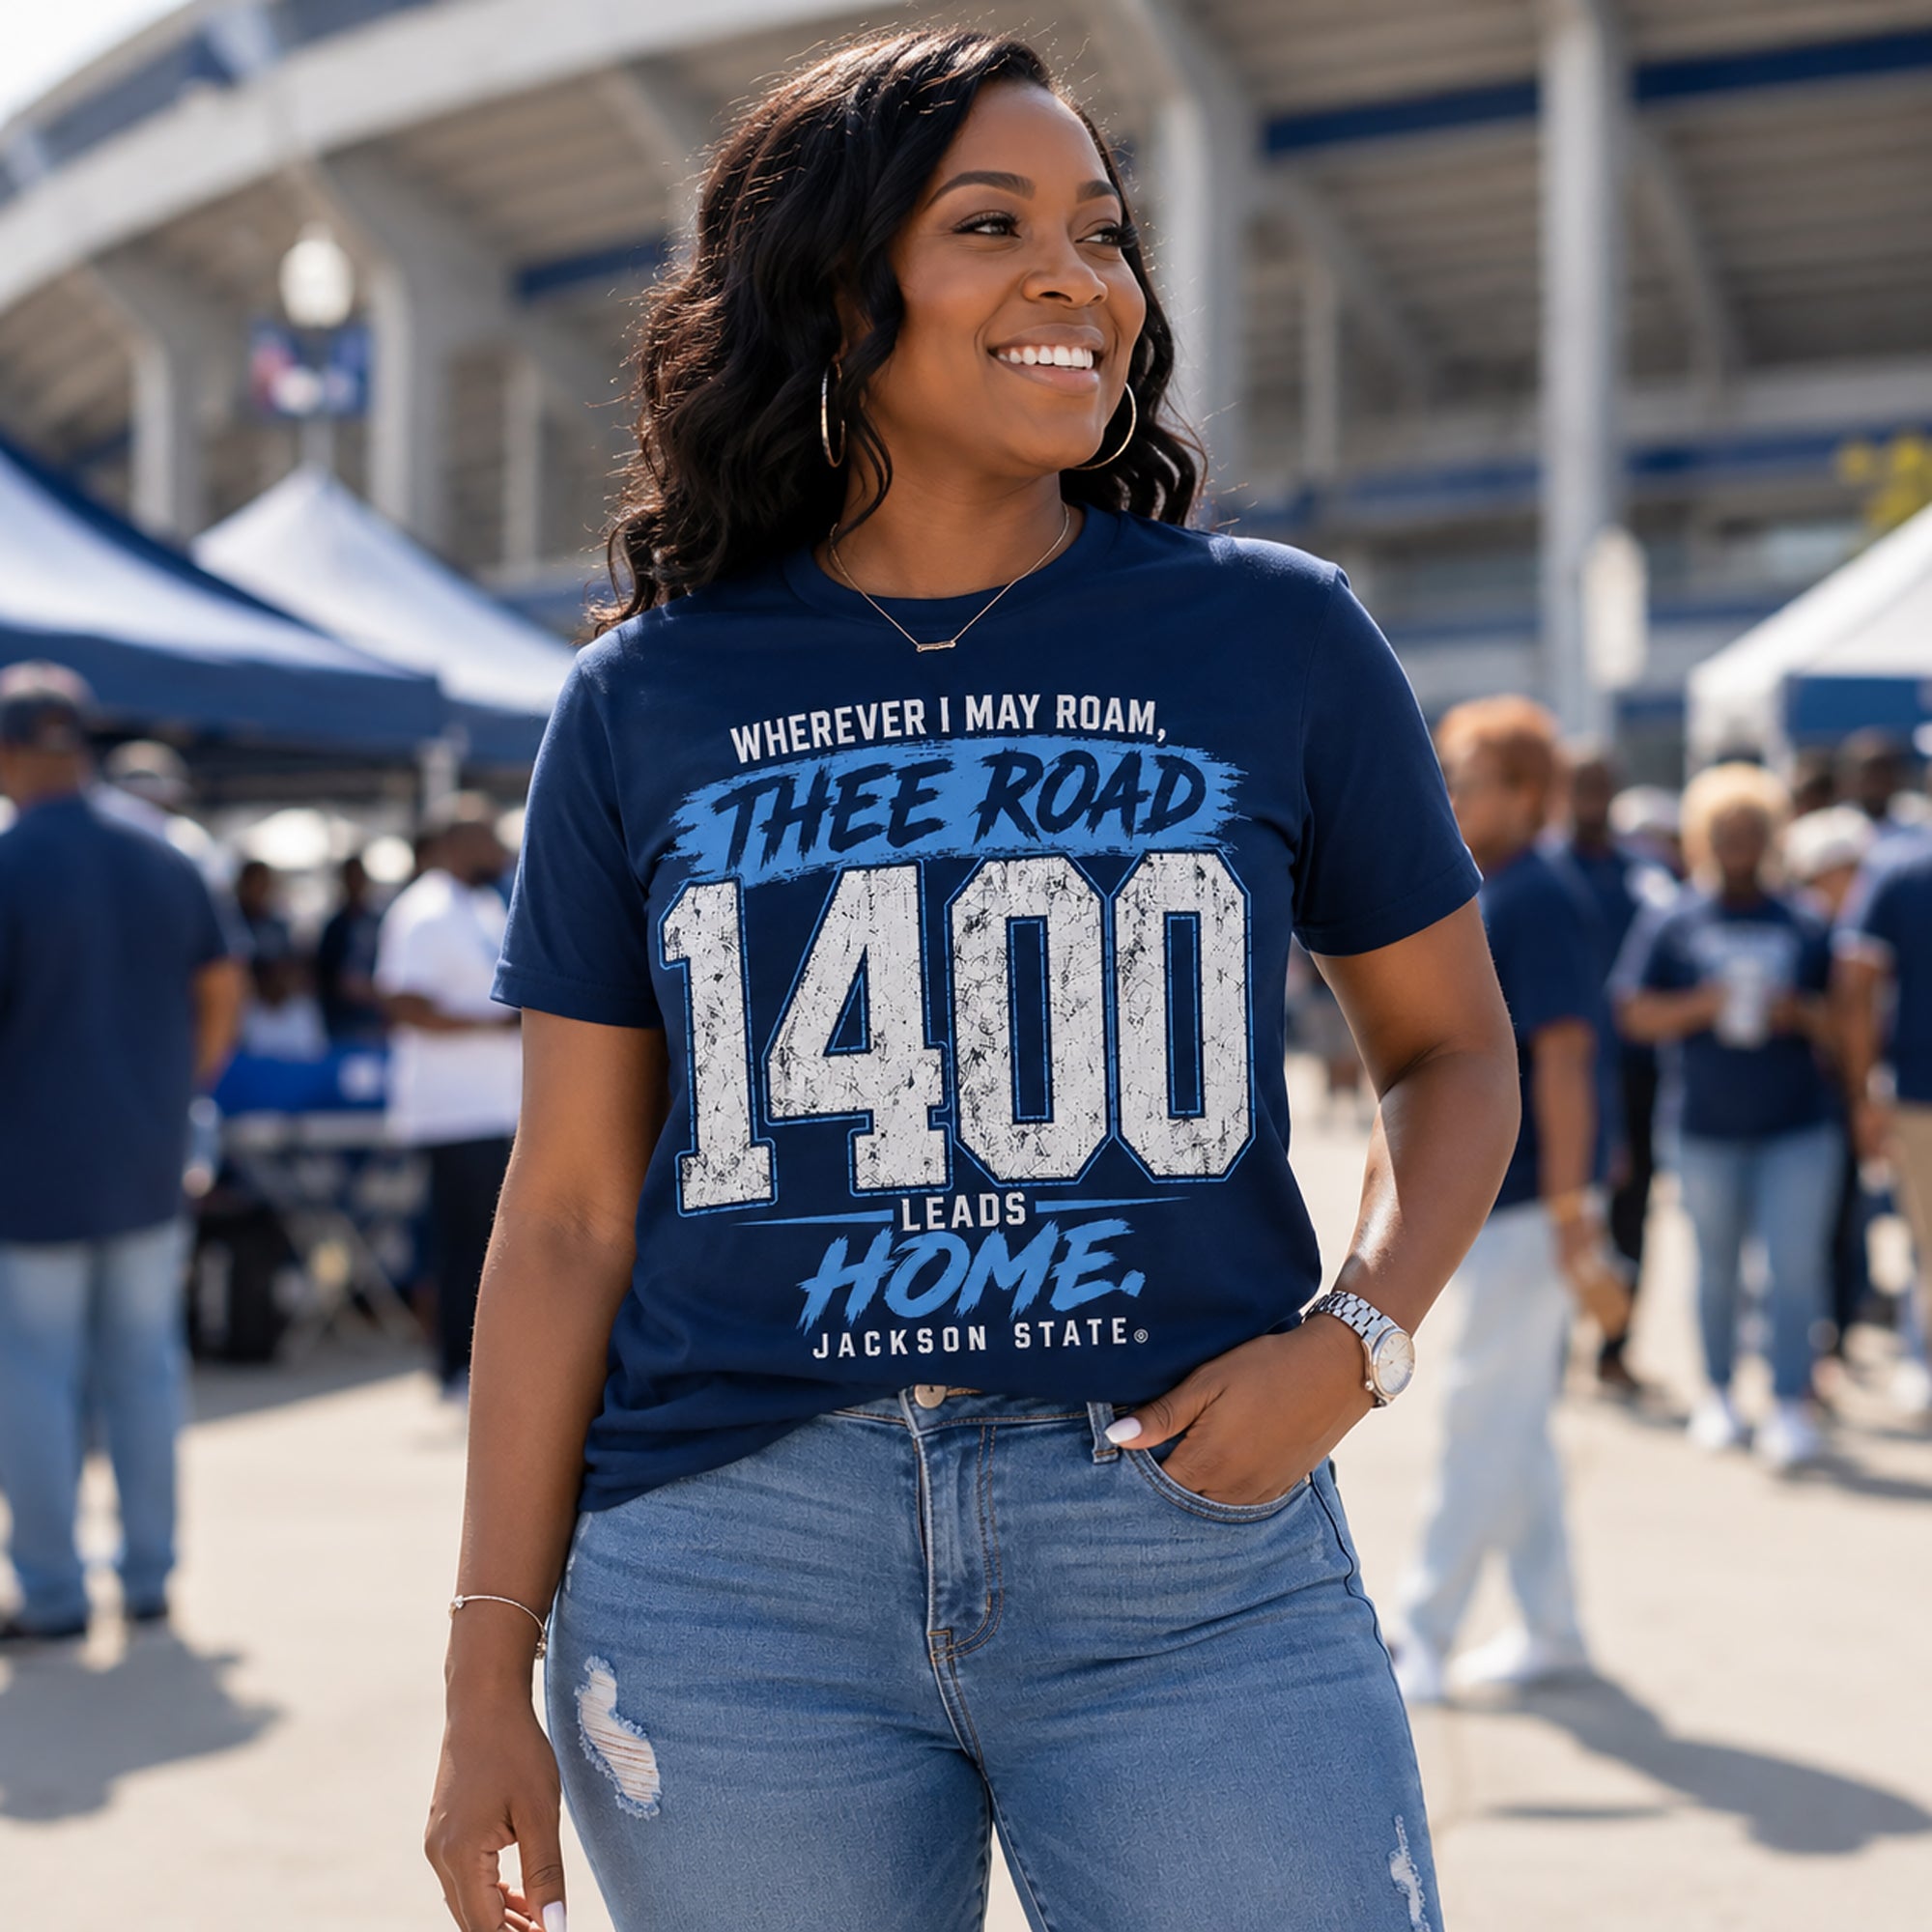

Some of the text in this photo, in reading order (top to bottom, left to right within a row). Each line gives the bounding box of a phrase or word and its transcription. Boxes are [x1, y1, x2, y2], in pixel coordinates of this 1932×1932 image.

[729, 694, 1167, 764] WHEREVER I MAY ROAM,
[712, 748, 1207, 870] THEE ROAD
[659, 849, 1253, 1215] 1400
[901, 1191, 1026, 1232] LEADS
[796, 1217, 1146, 1336] HOME.
[812, 1325, 986, 1359] JACKSON
